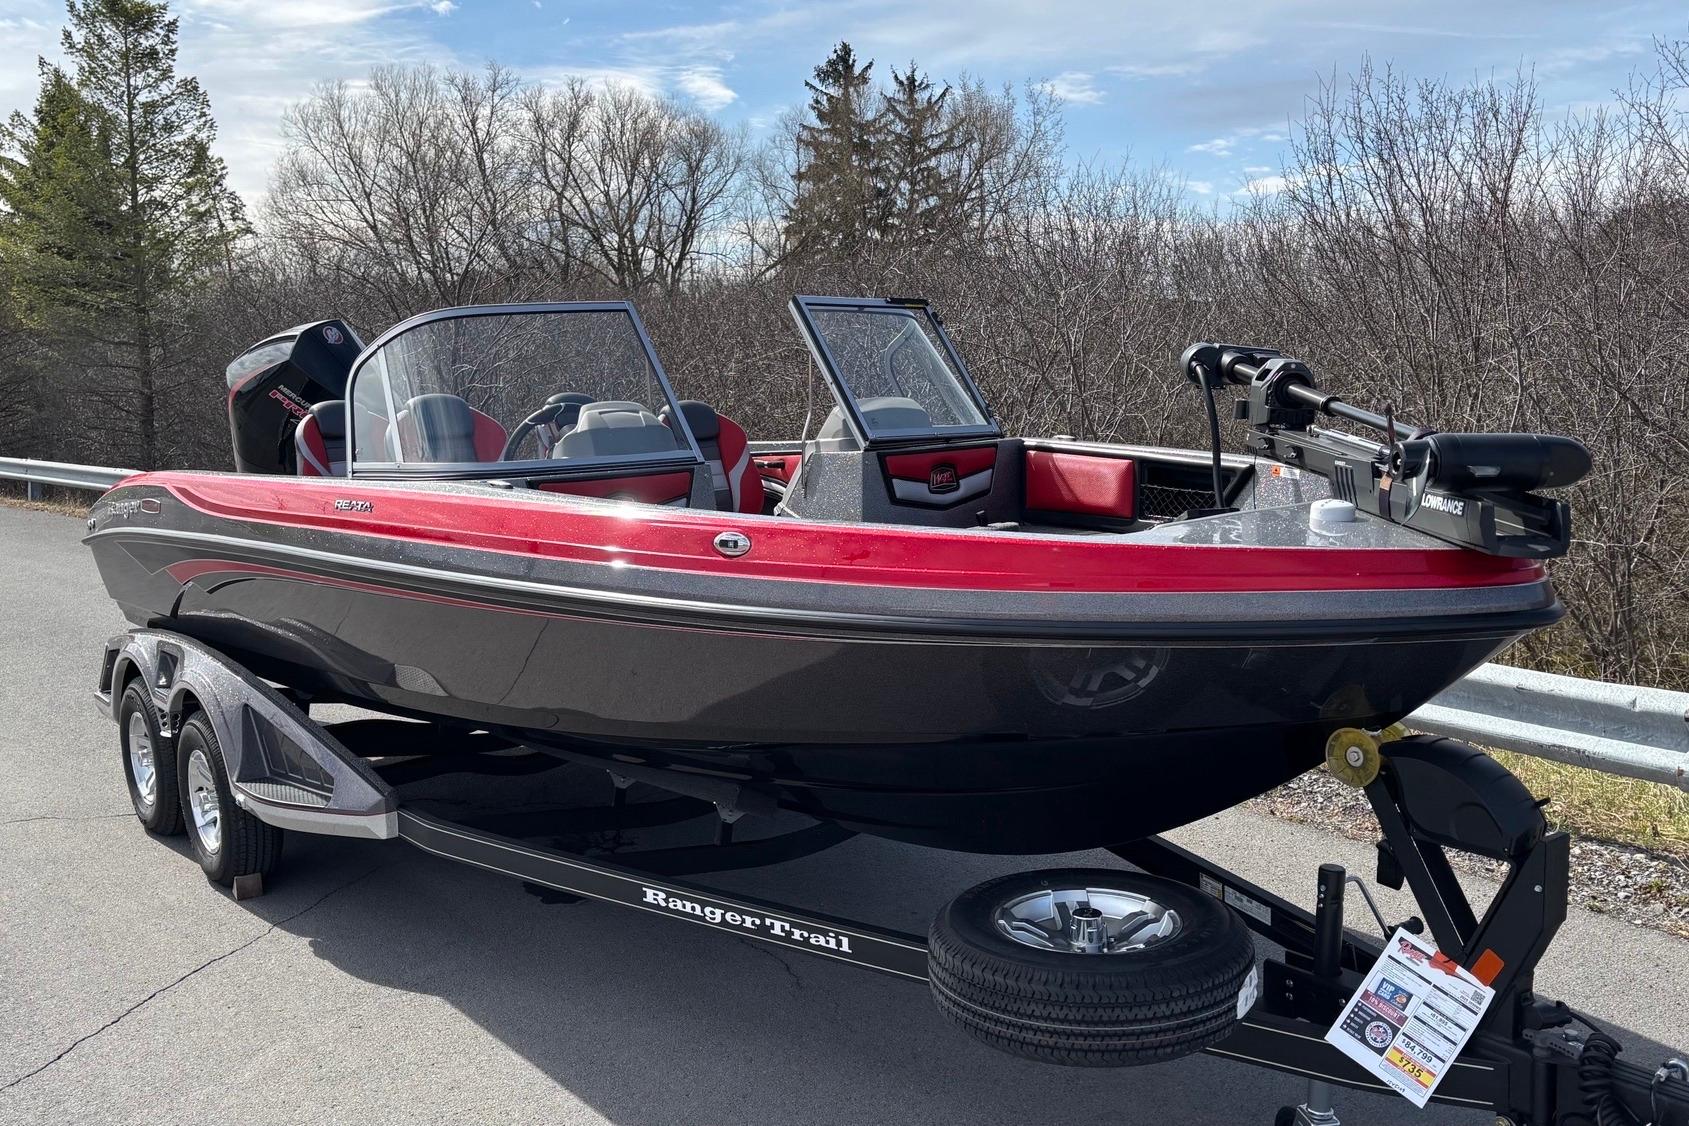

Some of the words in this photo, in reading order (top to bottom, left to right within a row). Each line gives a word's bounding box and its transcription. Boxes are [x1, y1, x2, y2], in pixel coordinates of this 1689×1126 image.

[278, 384, 312, 409] MERCUR
[335, 499, 374, 513] REATA
[1421, 493, 1465, 516] LOWRANCE
[642, 887, 761, 930] Ranger
[765, 918, 853, 954] Trail
[1382, 981, 1395, 992] VIP
[1378, 1002, 1400, 1020] DISCOUNT
[1402, 1038, 1433, 1064] $84,799
[1399, 1056, 1424, 1078] $735
